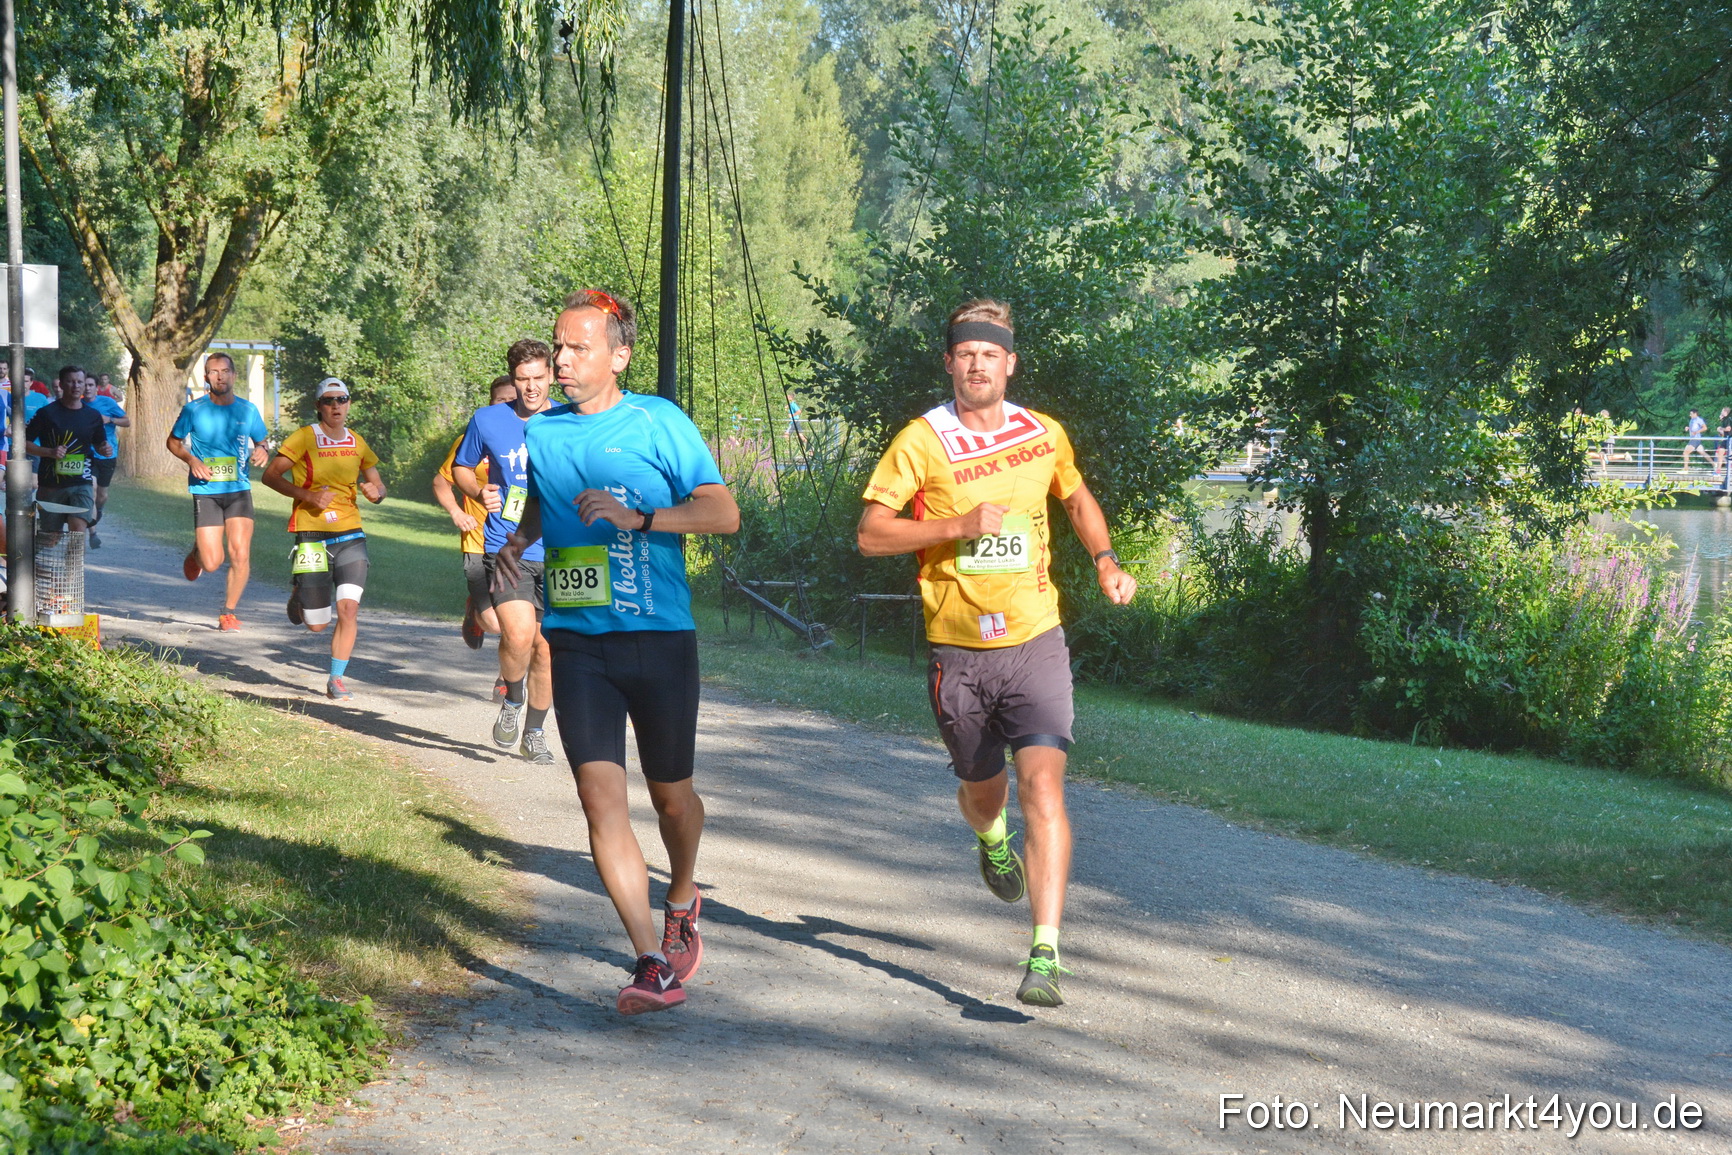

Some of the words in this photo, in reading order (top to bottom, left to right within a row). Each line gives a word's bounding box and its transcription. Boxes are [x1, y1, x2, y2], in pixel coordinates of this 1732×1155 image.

[59, 461, 81, 469] 1420
[953, 460, 1003, 485] MAX
[1005, 441, 1055, 468] BÖGL
[965, 536, 1022, 557] 1256
[550, 567, 599, 590] 1398
[641, 564, 656, 615] Nathalies
